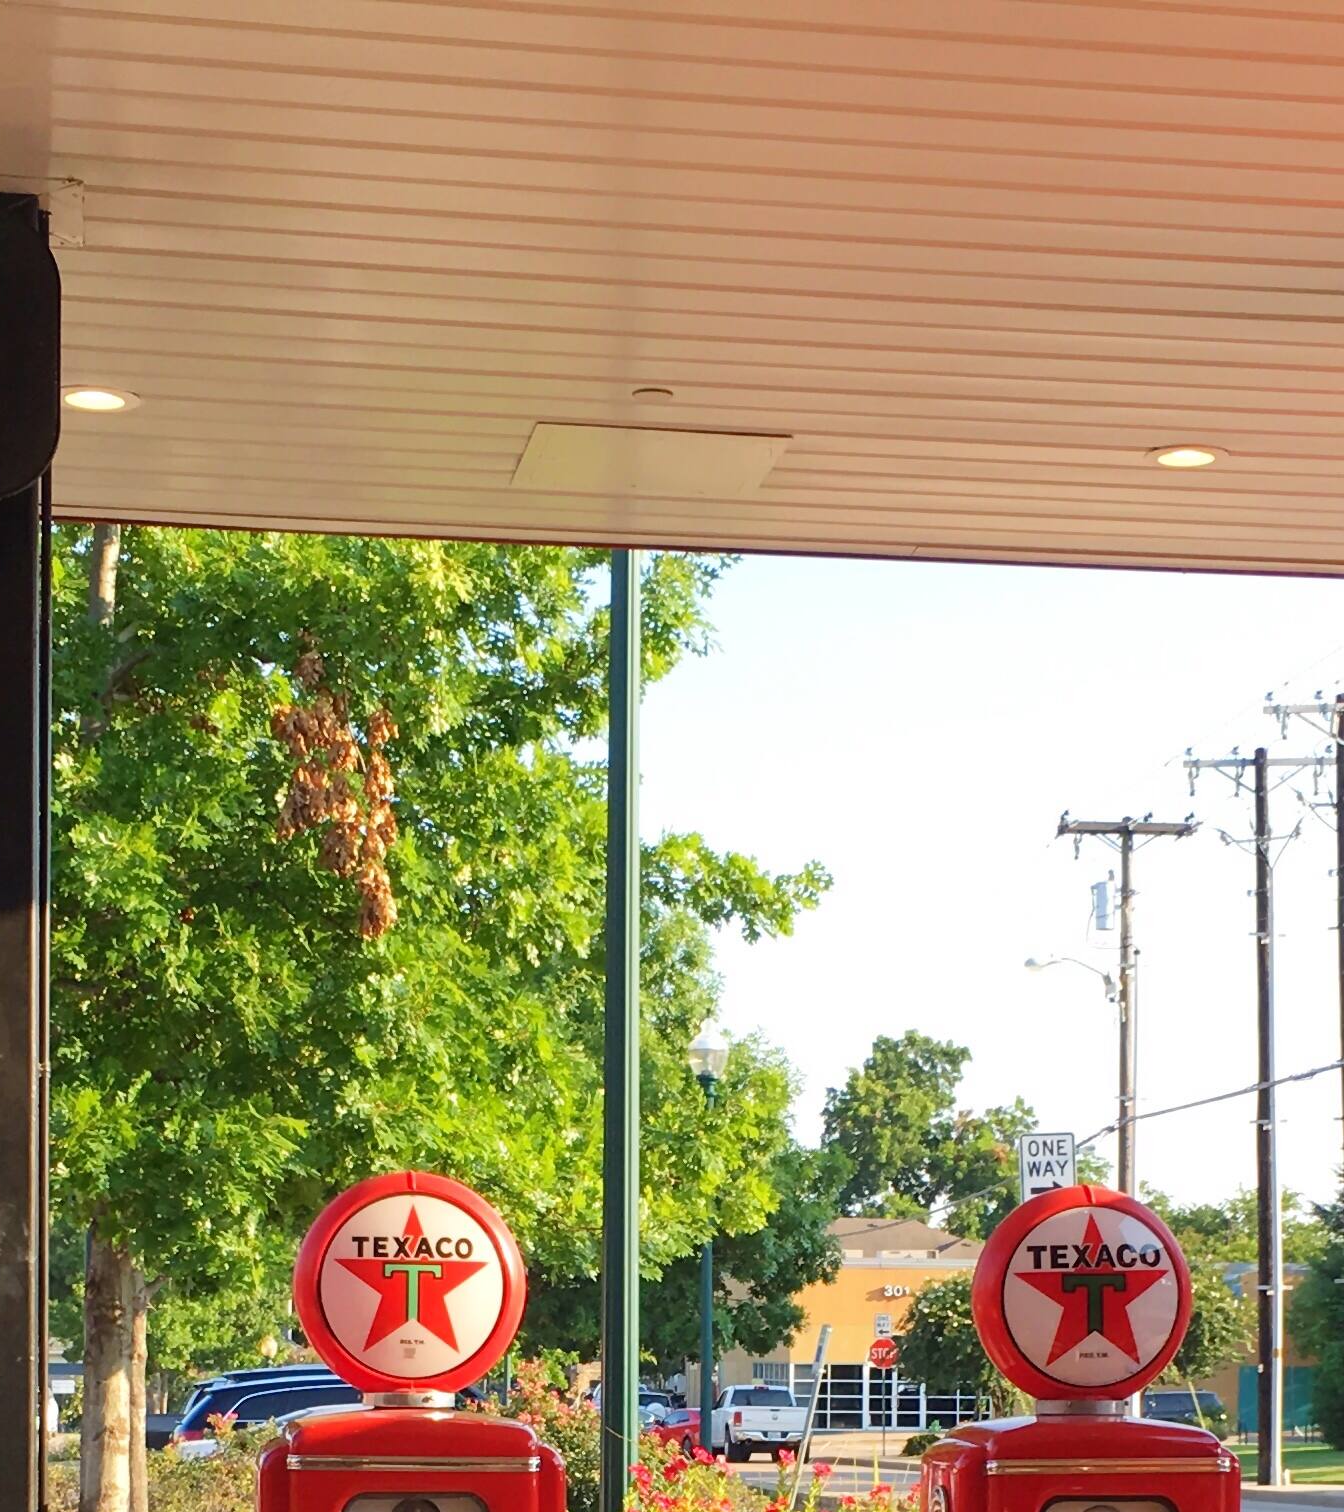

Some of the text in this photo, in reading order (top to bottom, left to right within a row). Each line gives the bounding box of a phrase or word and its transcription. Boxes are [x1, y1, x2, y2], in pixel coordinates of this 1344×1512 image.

[1027, 1139, 1068, 1157] ONE
[1027, 1159, 1069, 1178] WAY
[351, 1236, 474, 1258] TEXACO
[1026, 1244, 1161, 1269] TEXACO
[383, 1263, 442, 1323] T
[1061, 1273, 1126, 1334] T
